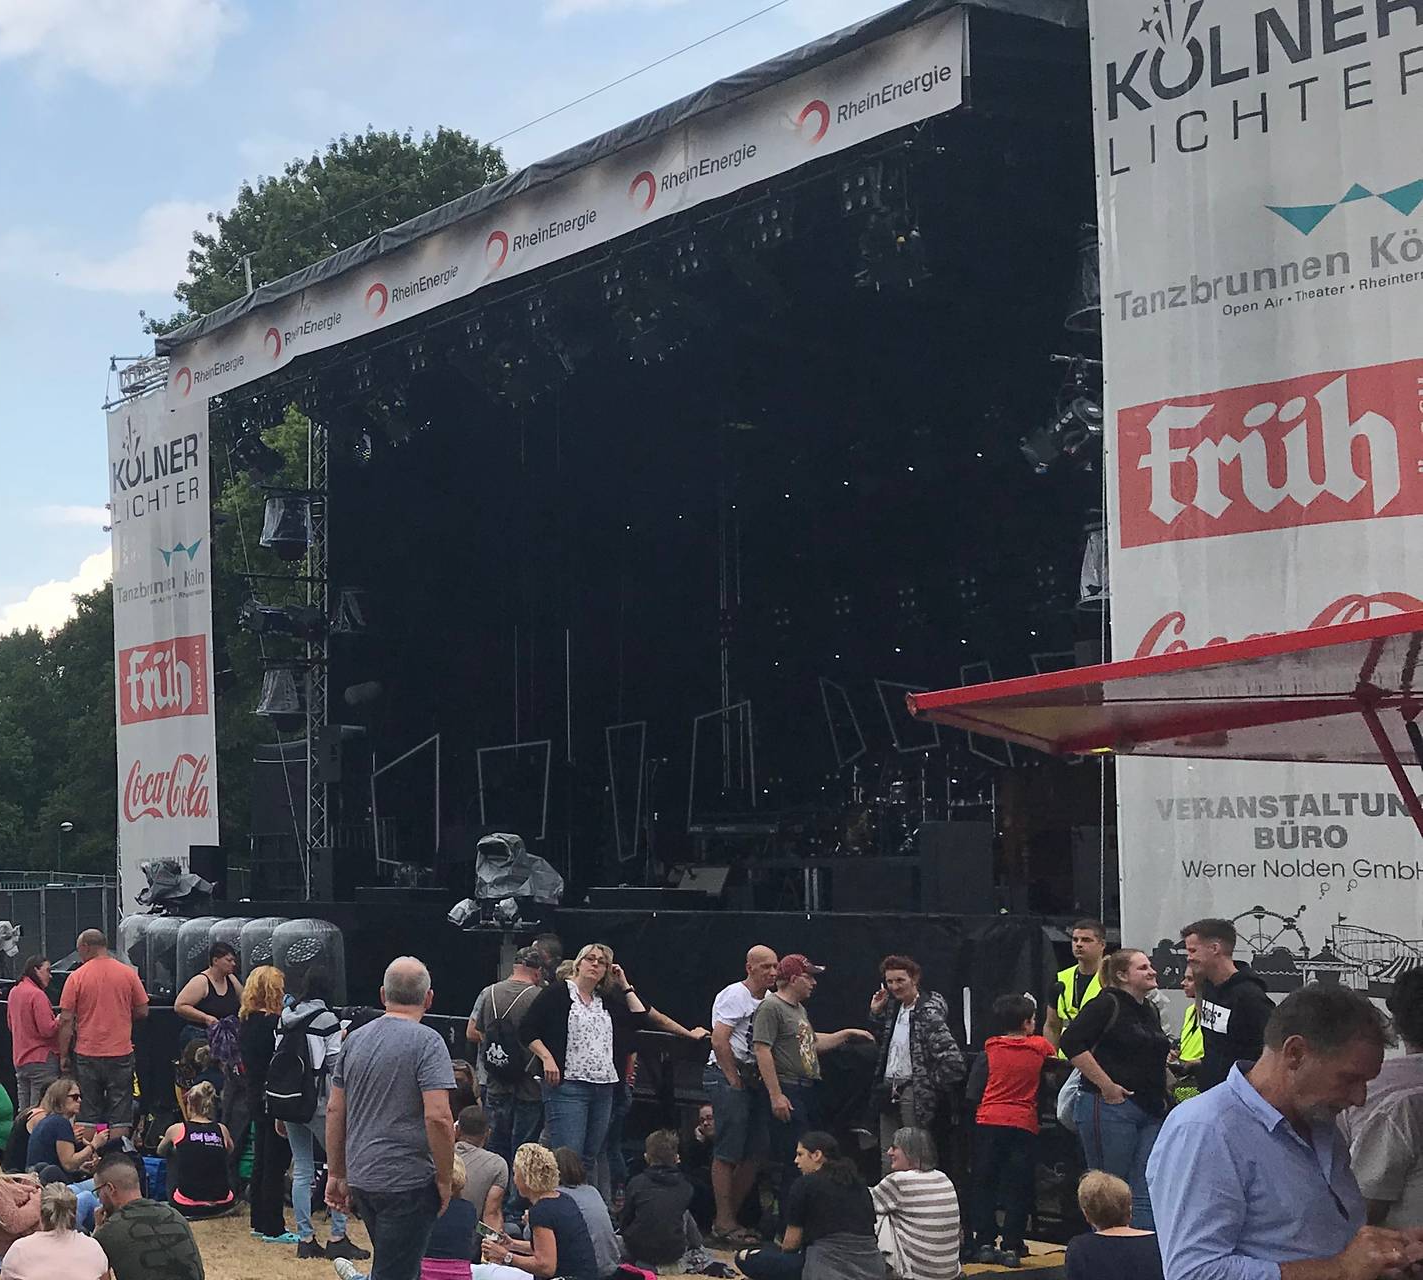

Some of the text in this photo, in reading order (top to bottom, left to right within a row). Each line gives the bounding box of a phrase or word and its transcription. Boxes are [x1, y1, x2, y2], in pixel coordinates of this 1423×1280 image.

[837, 64, 952, 124] RheinEnergie
[660, 144, 757, 192] RheinEnergie
[512, 208, 597, 252] RheinEnergie
[392, 264, 459, 303] RheinEnergie
[1114, 250, 1351, 321] Tanzbrunnen
[1222, 300, 1259, 317] Open
[1264, 297, 1285, 313] Air
[1295, 284, 1345, 301] Theater
[284, 311, 342, 346] RhnEnergie
[113, 433, 198, 494] KÖLNER
[113, 476, 199, 524] LICHTER
[184, 568, 205, 588] Köln
[124, 753, 210, 823] Coca-Cola
[1156, 792, 1423, 821] VERANSTALTUN
[1254, 820, 1348, 849] BÜRO
[1181, 860, 1256, 879] Werner
[1263, 859, 1345, 878] Nolden
